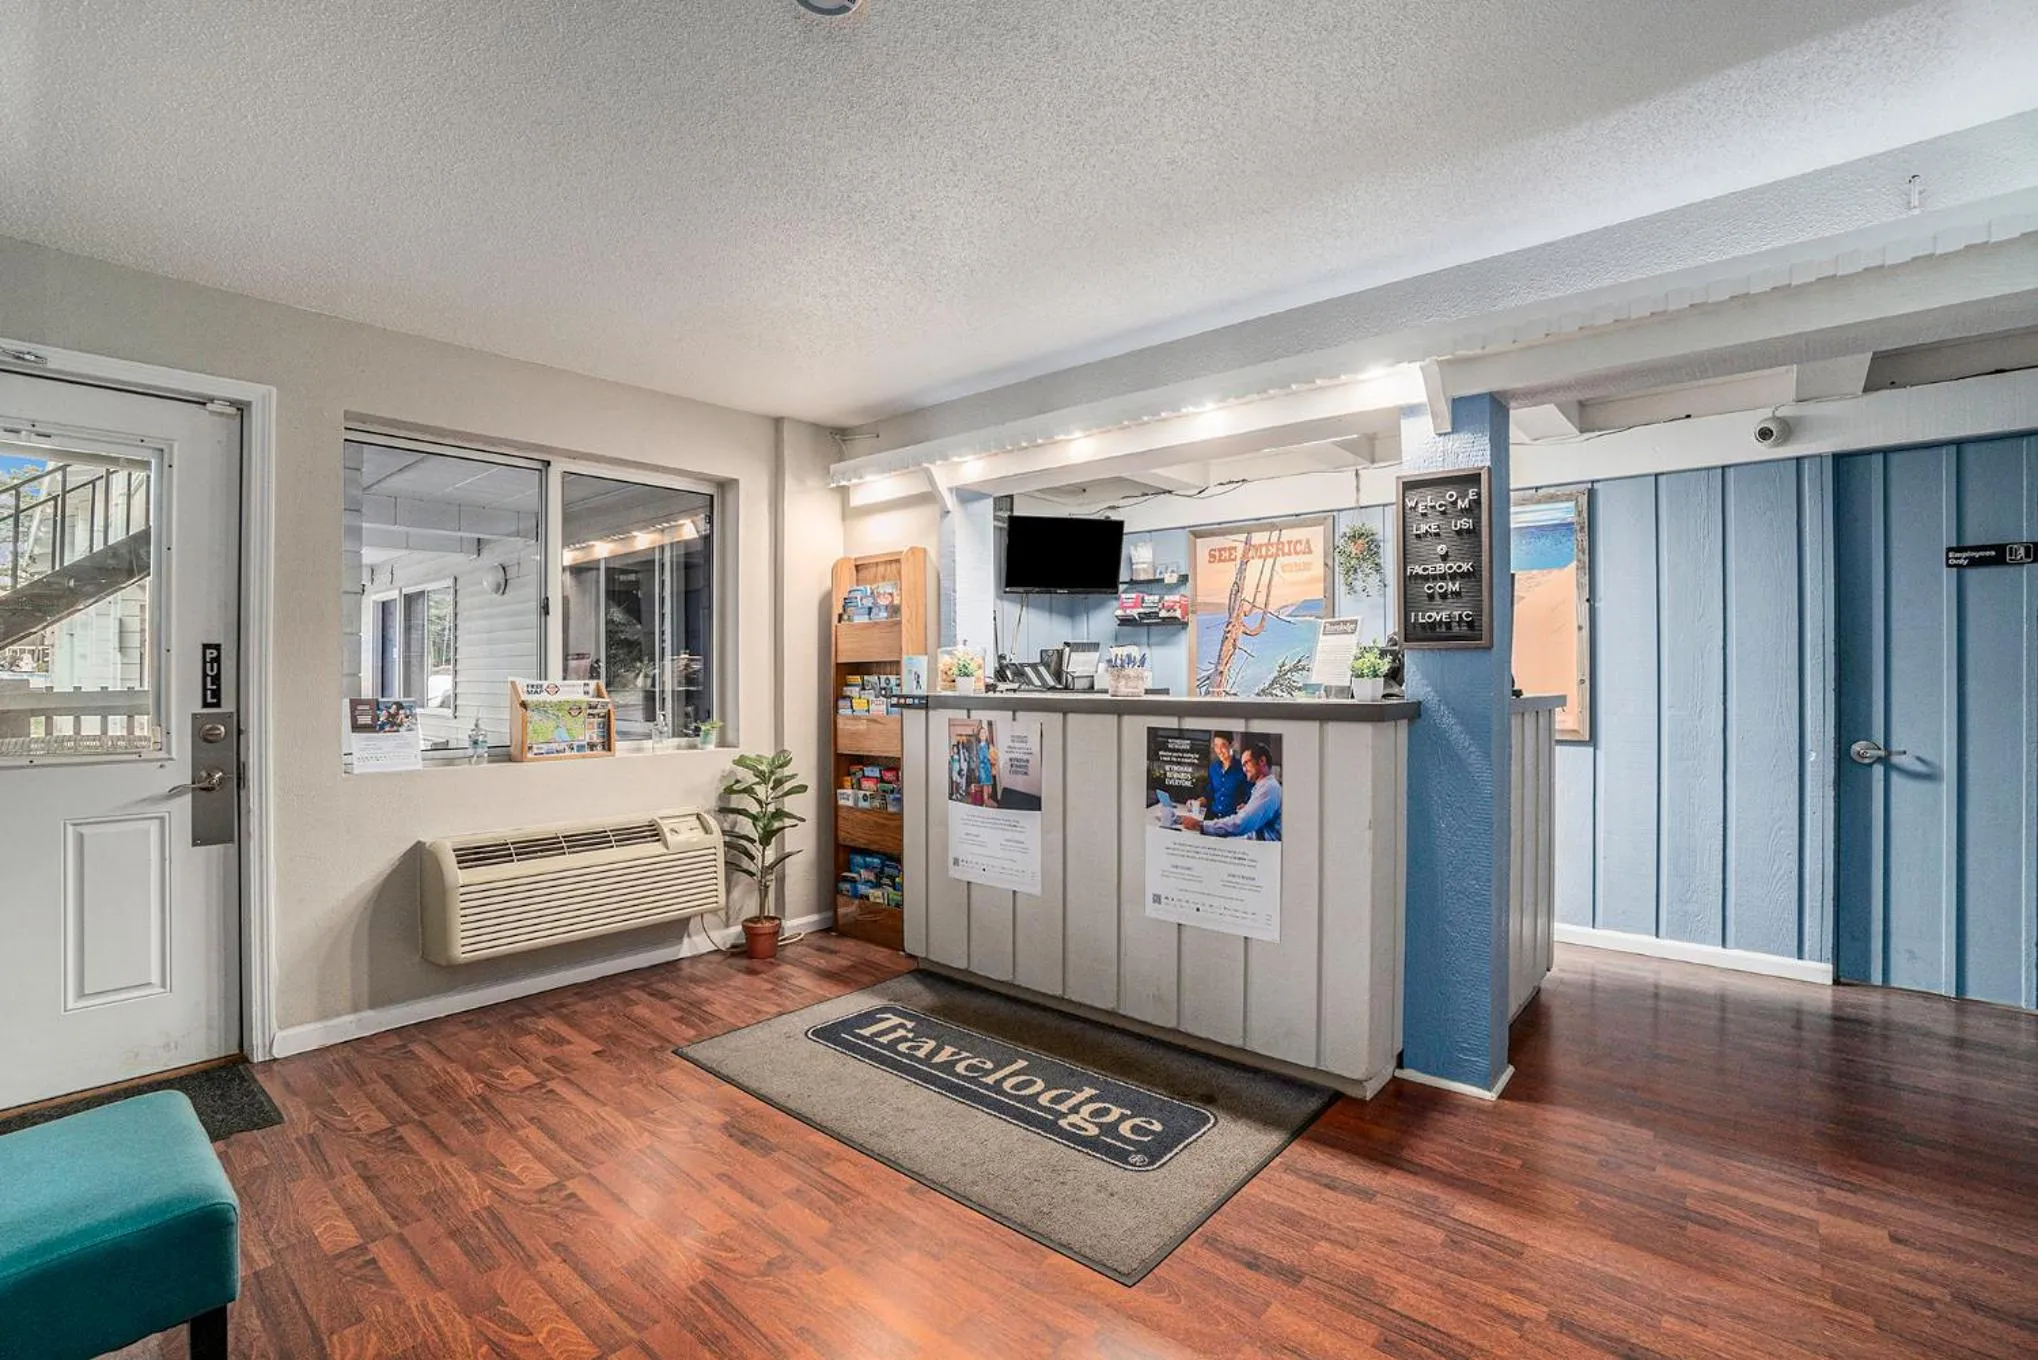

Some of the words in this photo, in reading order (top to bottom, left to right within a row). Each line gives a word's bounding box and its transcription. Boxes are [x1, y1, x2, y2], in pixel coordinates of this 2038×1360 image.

[1406, 489, 1479, 514] WELCOME
[1413, 522, 1440, 535] LIKE
[1208, 546, 1237, 563] SEE
[1240, 538, 1313, 561] AMERICA
[1406, 561, 1474, 576] FACEBOOK
[1424, 582, 1461, 594] COM
[206, 649, 218, 703] PULL
[854, 1013, 1164, 1138] Travelodge
